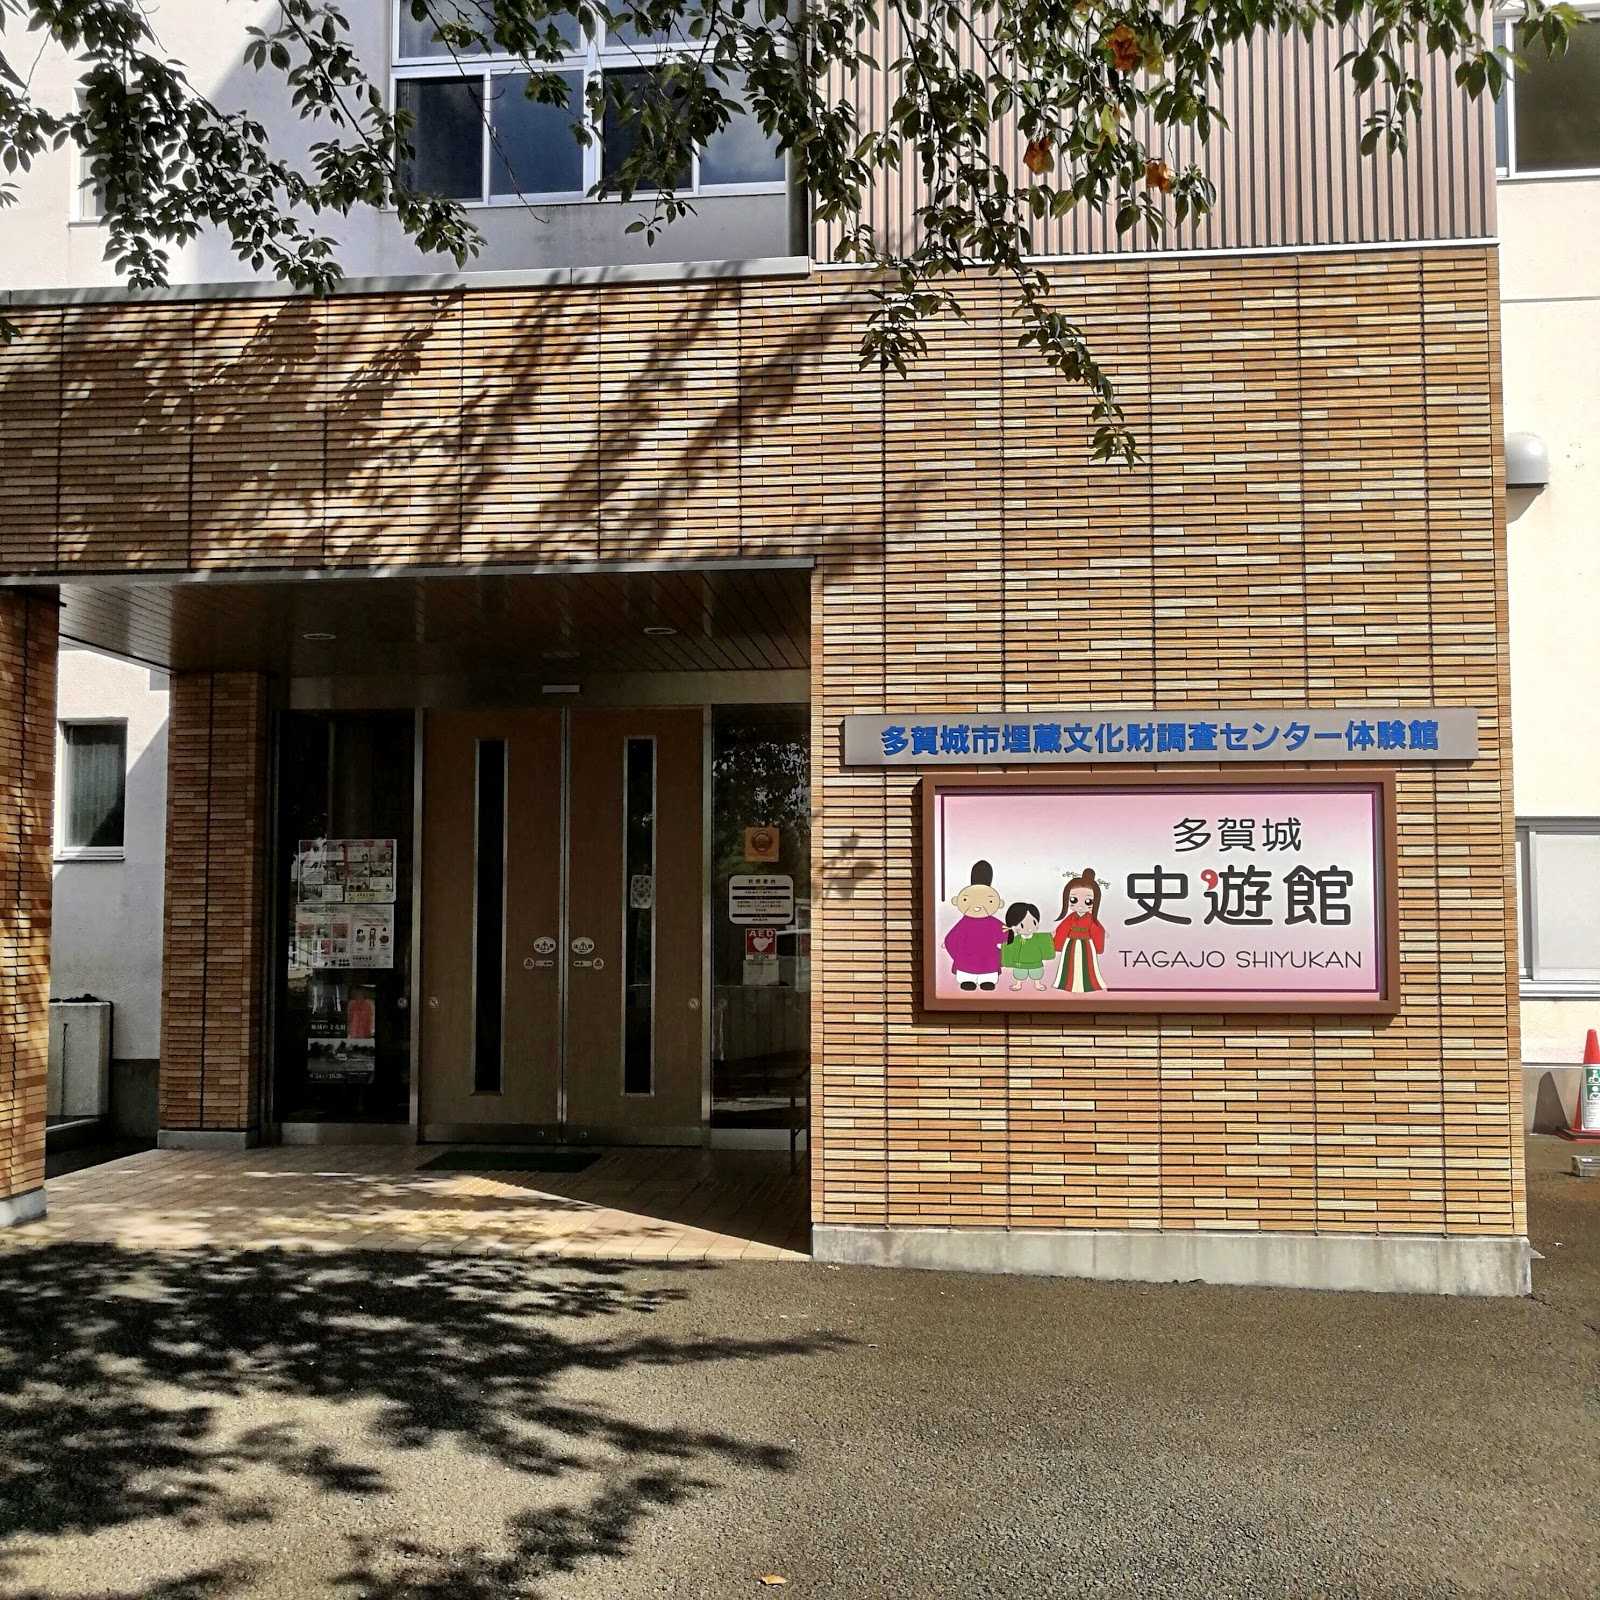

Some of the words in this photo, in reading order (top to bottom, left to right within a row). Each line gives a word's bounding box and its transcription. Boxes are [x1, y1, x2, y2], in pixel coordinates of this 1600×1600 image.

[881, 719, 1439, 756] 多賀城市埋蔵文化財調査センター体験館
[1173, 817, 1302, 853] 多賀城
[1124, 864, 1354, 926] 史遊館
[749, 929, 774, 937] AED
[1119, 950, 1226, 969] TAGAJO
[1236, 950, 1362, 969] SHIYUKAN
